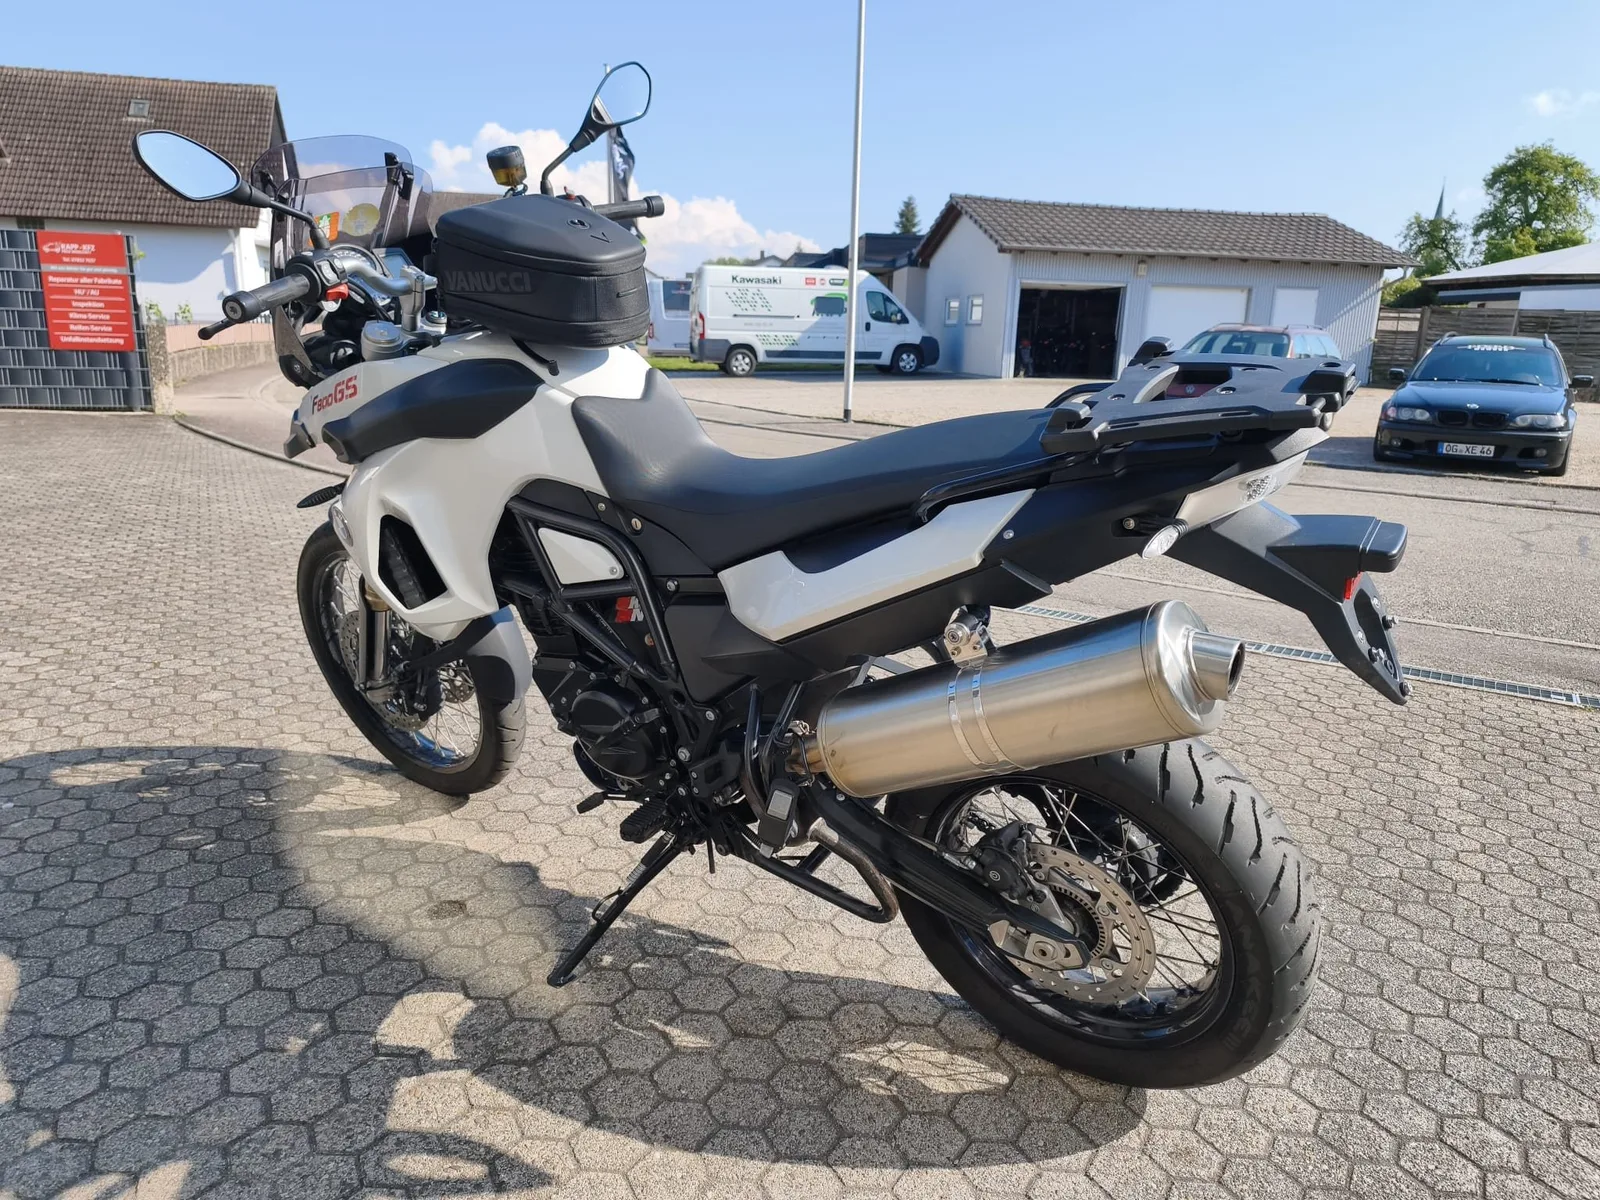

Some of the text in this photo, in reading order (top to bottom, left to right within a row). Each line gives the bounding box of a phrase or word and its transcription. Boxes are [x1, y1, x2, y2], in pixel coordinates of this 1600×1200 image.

[445, 270, 532, 293] VANUCCI
[731, 275, 782, 285] Kawasaki
[72, 301, 105, 309] Inspektion
[1445, 444, 1492, 456] OG XE 46
